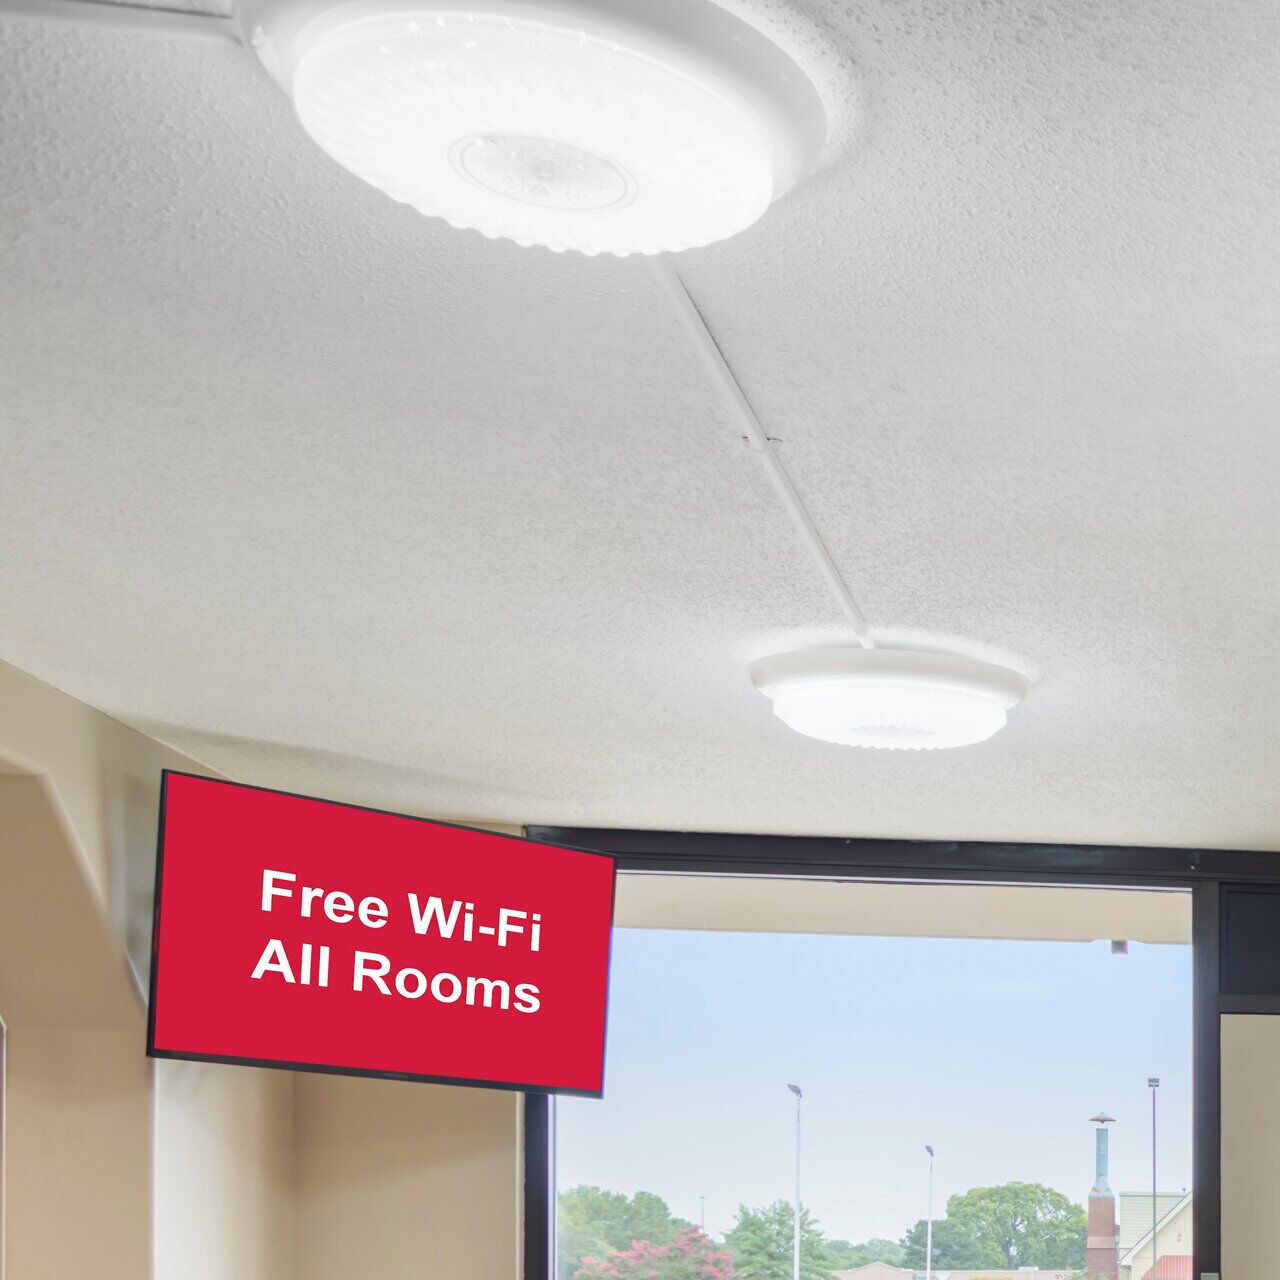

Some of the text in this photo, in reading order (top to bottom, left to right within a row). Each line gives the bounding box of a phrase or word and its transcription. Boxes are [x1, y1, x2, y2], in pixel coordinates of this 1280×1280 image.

[261, 869, 542, 952] Free Wi-Fi
[251, 939, 541, 1014] All Rooms
